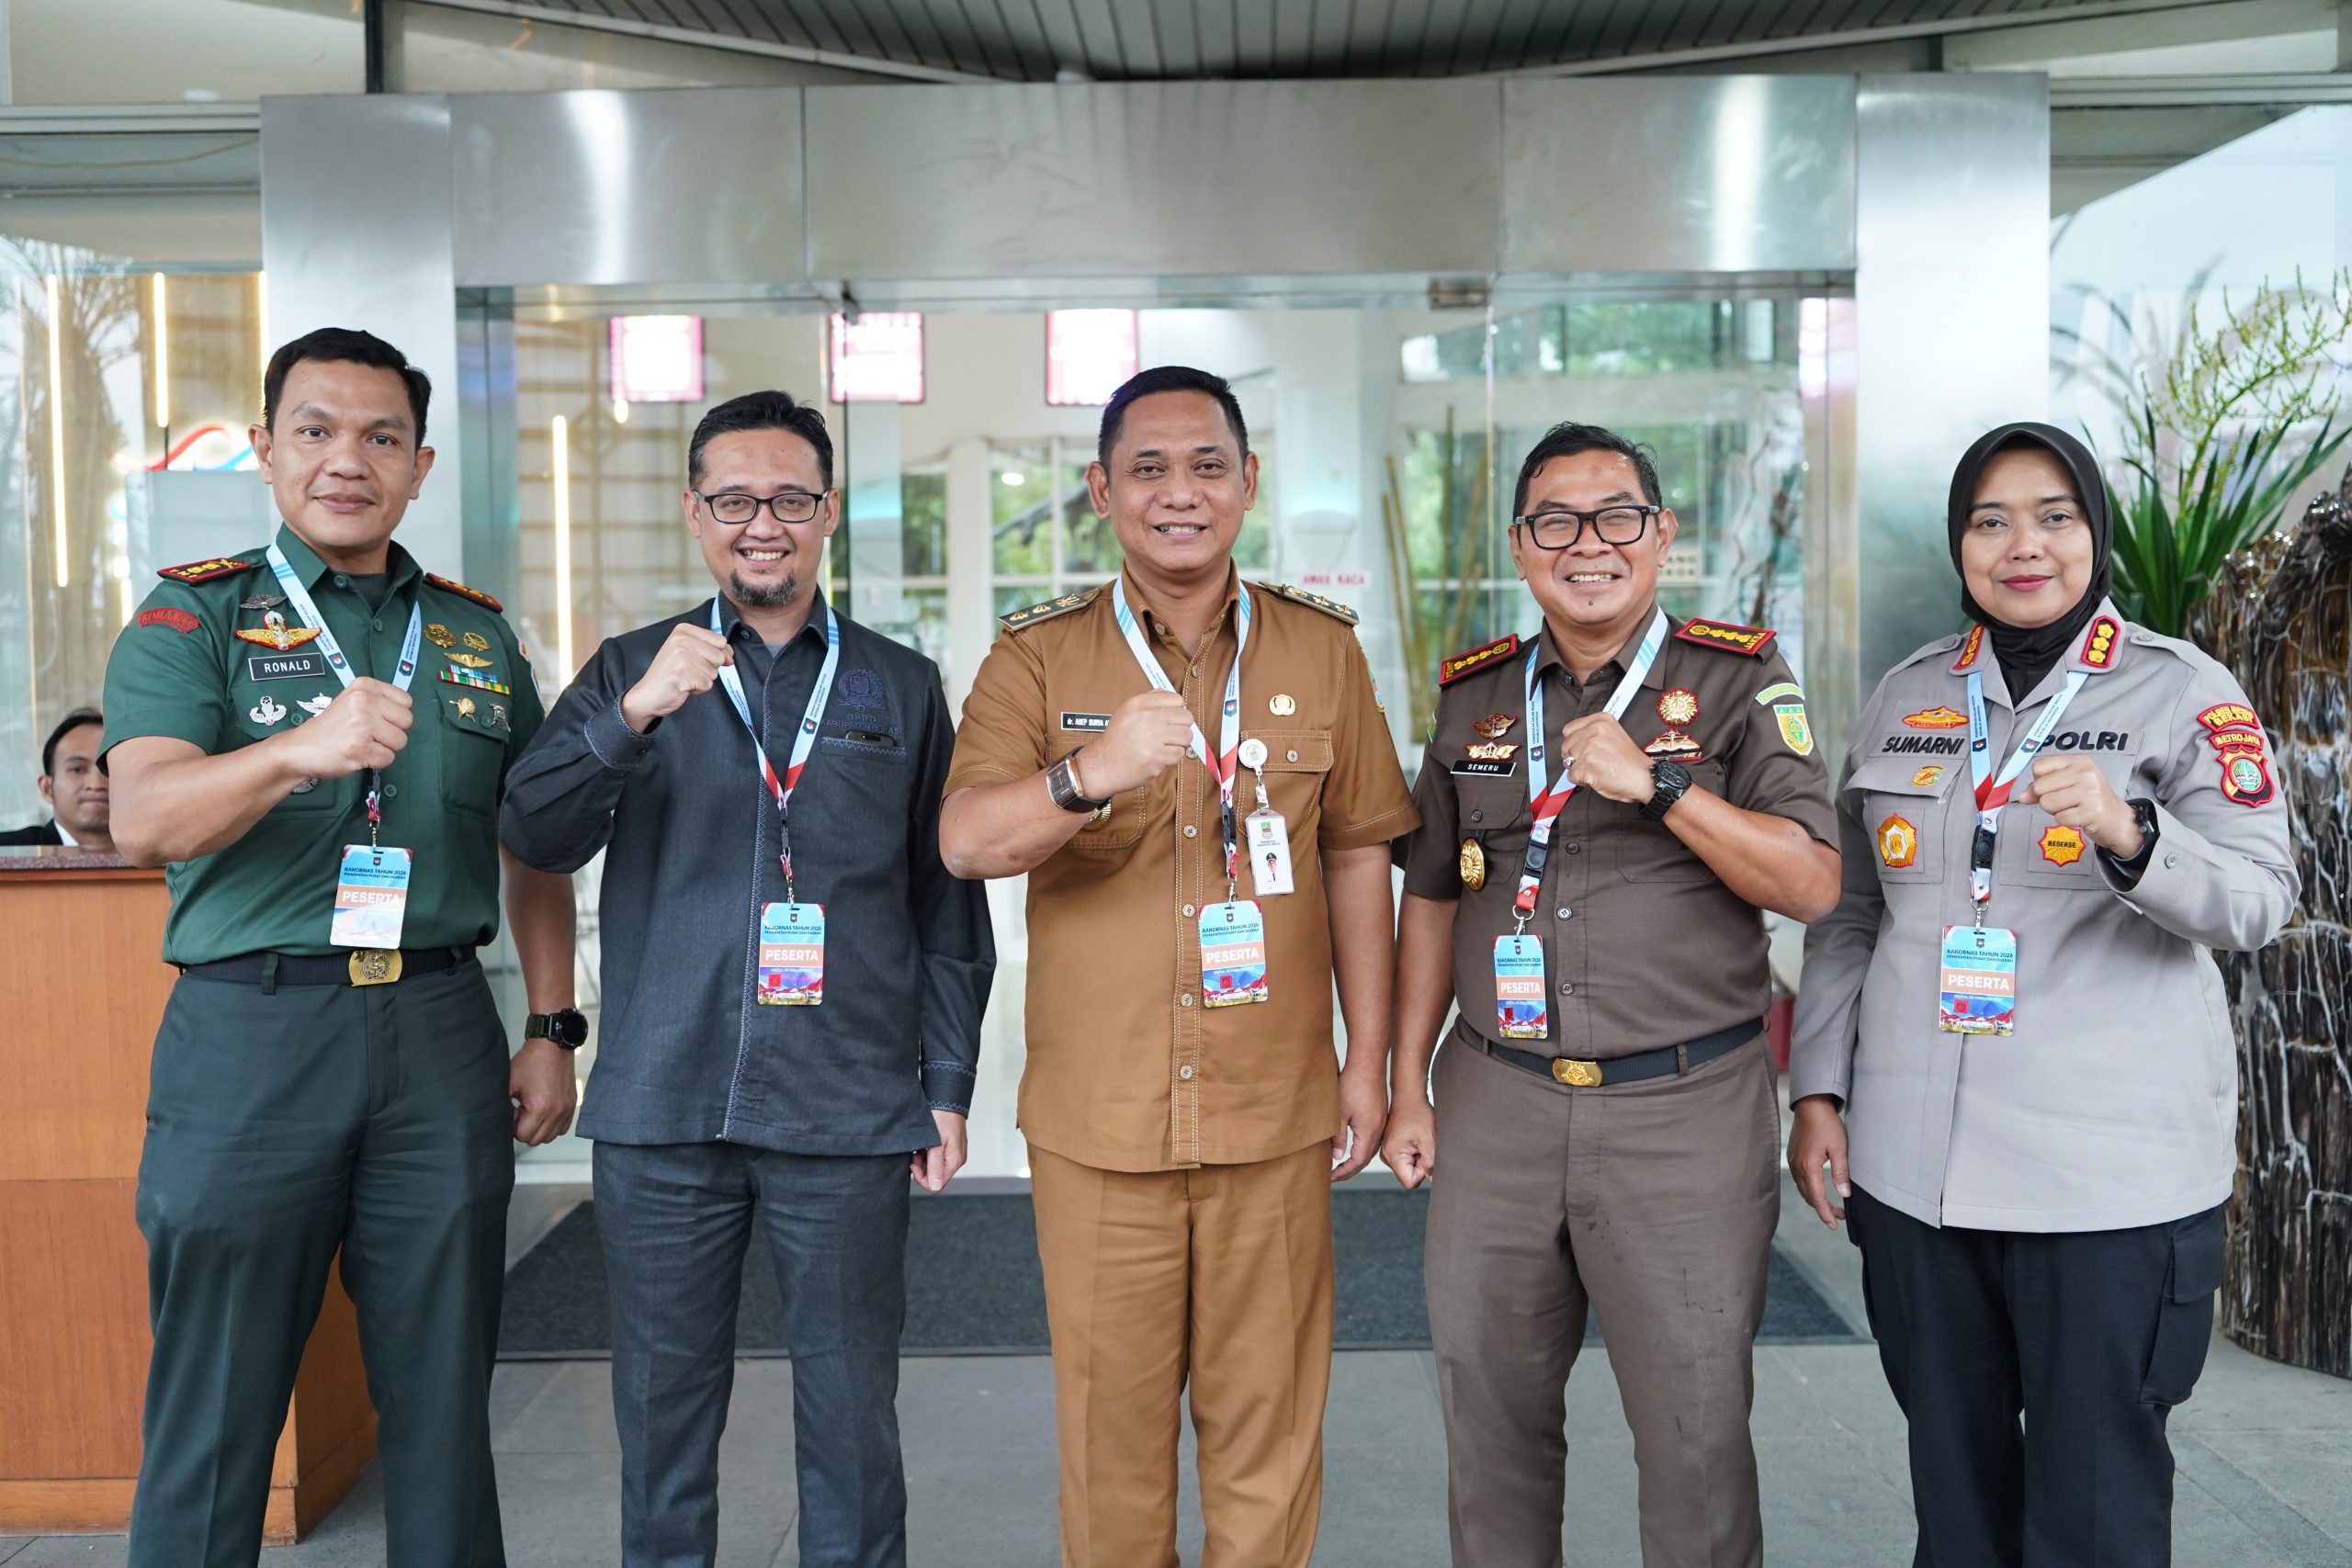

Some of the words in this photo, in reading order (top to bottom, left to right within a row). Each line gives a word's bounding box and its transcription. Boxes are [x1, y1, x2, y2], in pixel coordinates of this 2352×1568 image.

[264, 660, 311, 673] RONALD
[821, 719, 870, 729] KABUPATEN
[847, 714, 876, 723] DPRD
[1075, 717, 1088, 726] ASEP
[1882, 736, 1965, 754] SUMARNI
[2036, 731, 2129, 752] POLRI
[1467, 763, 1499, 772] SEMERU
[2047, 840, 2076, 849] RESERSE
[765, 949, 819, 962] PESERTA
[1205, 947, 1259, 964] PESERTA
[1500, 982, 1541, 994] PESERTA
[1948, 974, 2009, 990] PESERTA
